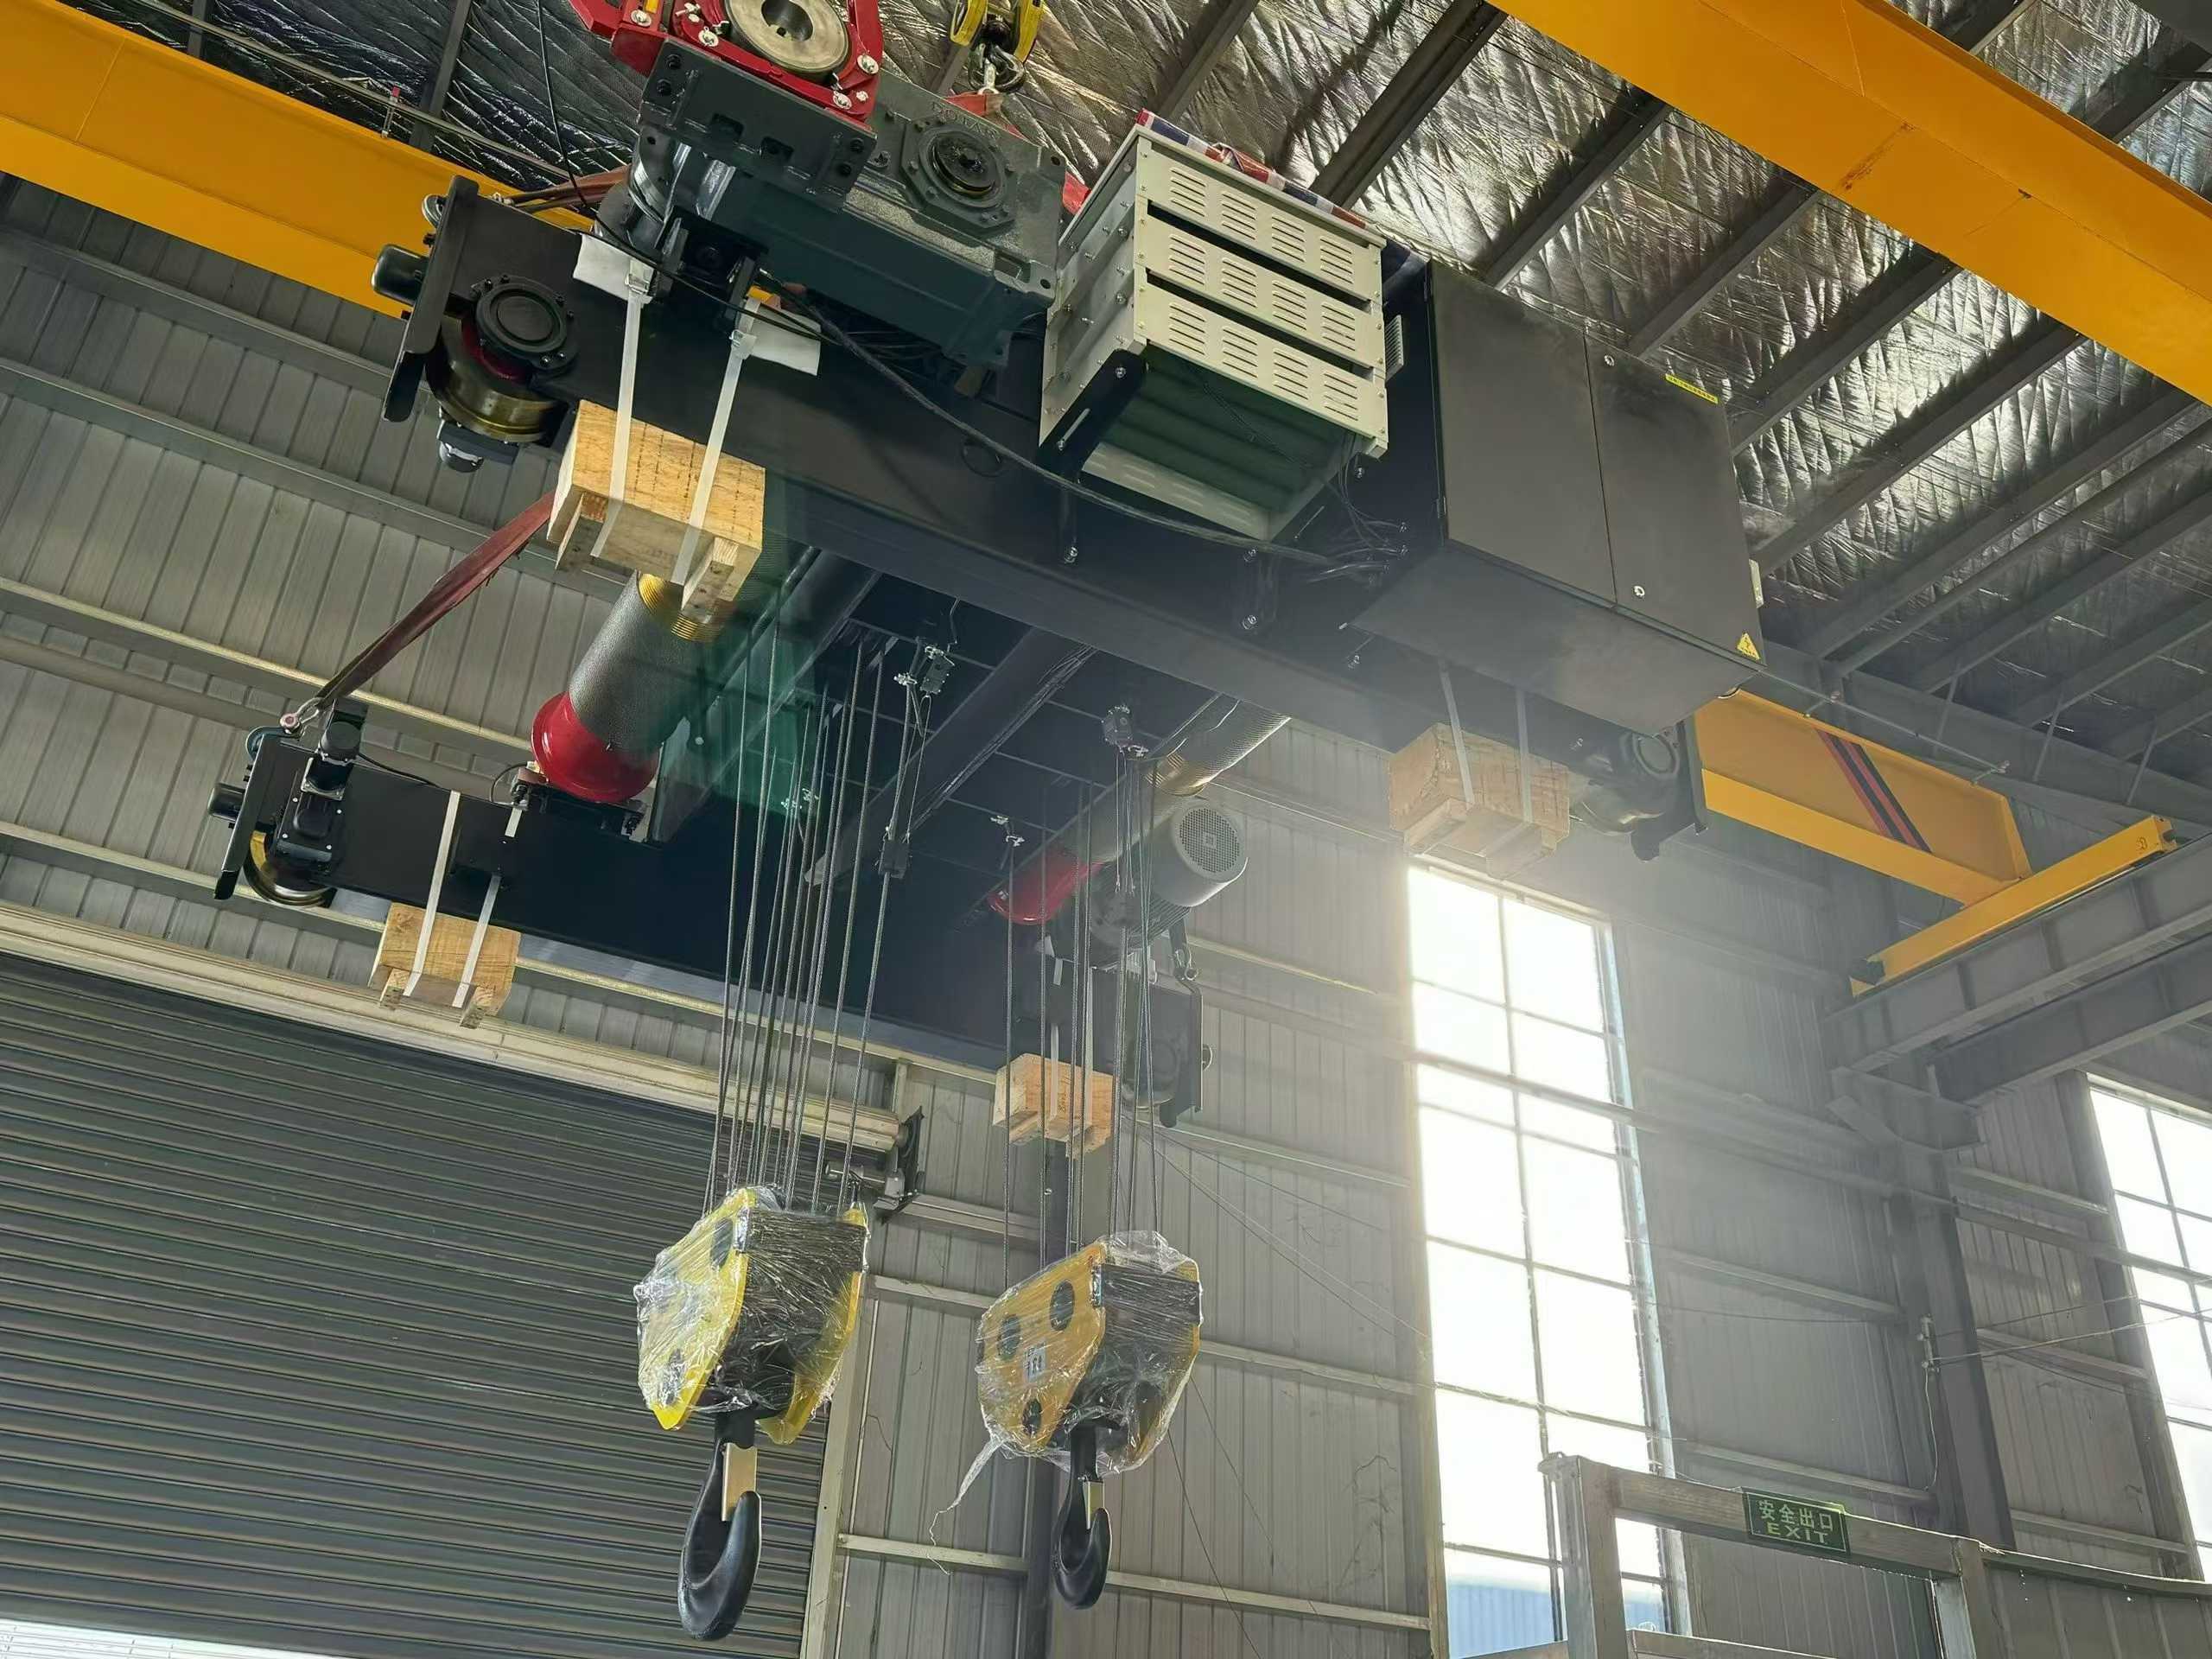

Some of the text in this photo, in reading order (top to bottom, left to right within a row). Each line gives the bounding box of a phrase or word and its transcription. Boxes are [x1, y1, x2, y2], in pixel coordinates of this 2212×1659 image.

[1758, 1500, 1833, 1532] 安全出口
[1767, 1522, 1828, 1544] EXIT
